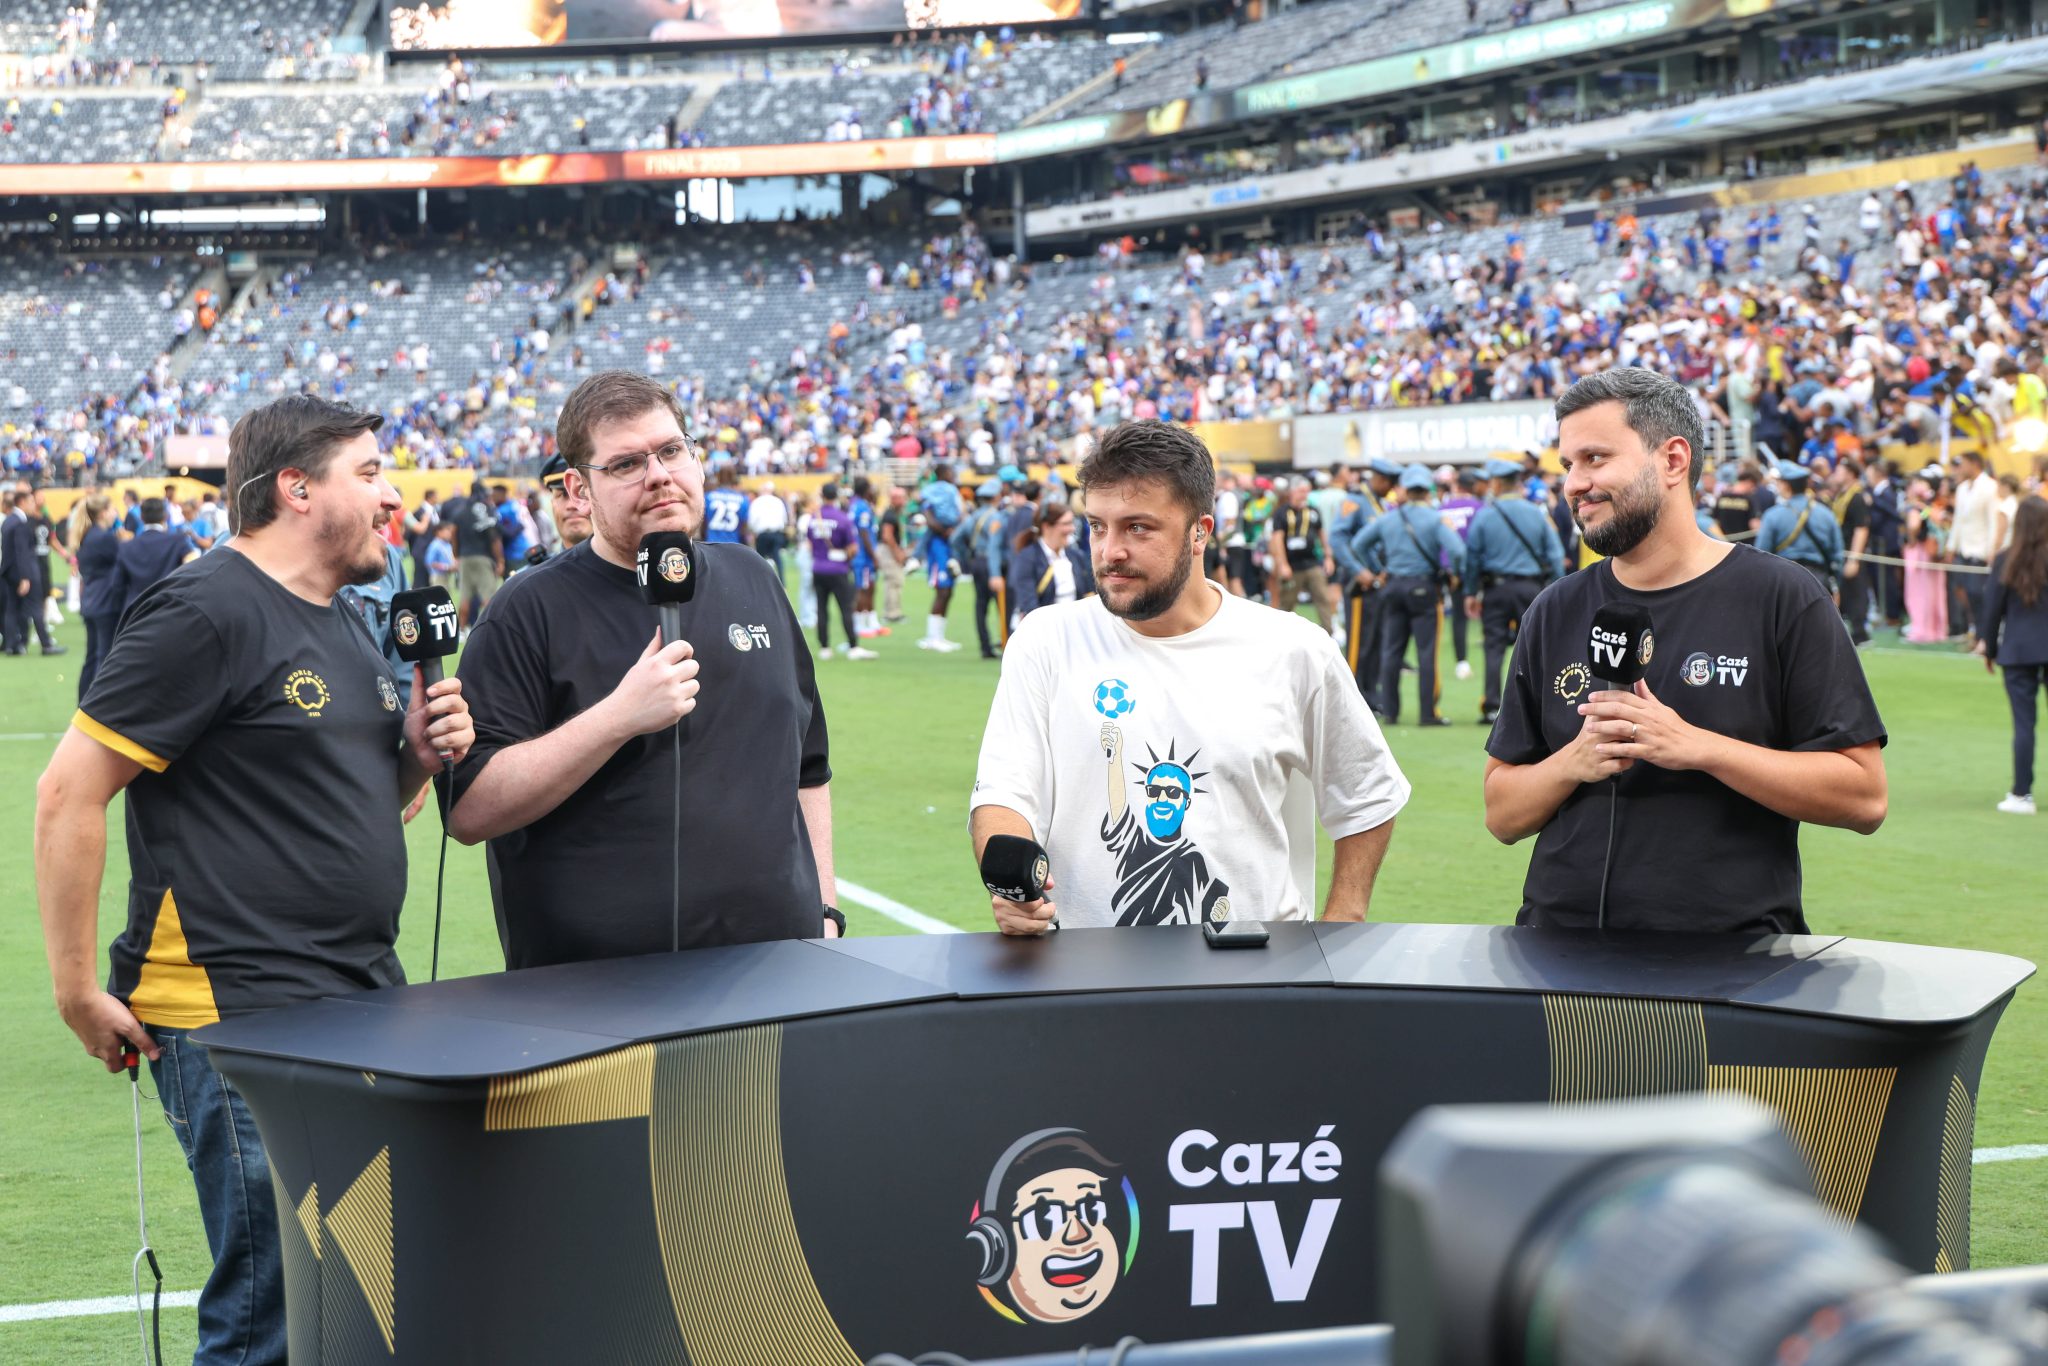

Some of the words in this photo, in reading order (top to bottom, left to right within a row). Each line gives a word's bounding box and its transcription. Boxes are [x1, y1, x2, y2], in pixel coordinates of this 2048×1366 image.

[644, 152, 695, 176] FINAL
[709, 500, 739, 532] 23
[428, 600, 454, 616] Cazé
[431, 614, 457, 640] TV
[748, 624, 767, 633] Cazé
[1592, 626, 1627, 646] Cazé
[752, 634, 771, 649] TV
[1590, 640, 1626, 668] TV
[1717, 655, 1749, 667] Cazé
[287, 669, 313, 682] WORLD
[1554, 675, 1562, 694] CLUB
[1561, 662, 1582, 675] WORLD
[1582, 665, 1591, 677] CUP
[1717, 667, 1748, 687] TV
[986, 882, 1023, 894] Cazé
[1168, 1125, 1342, 1188] Cazé
[1169, 1198, 1342, 1306] TV
